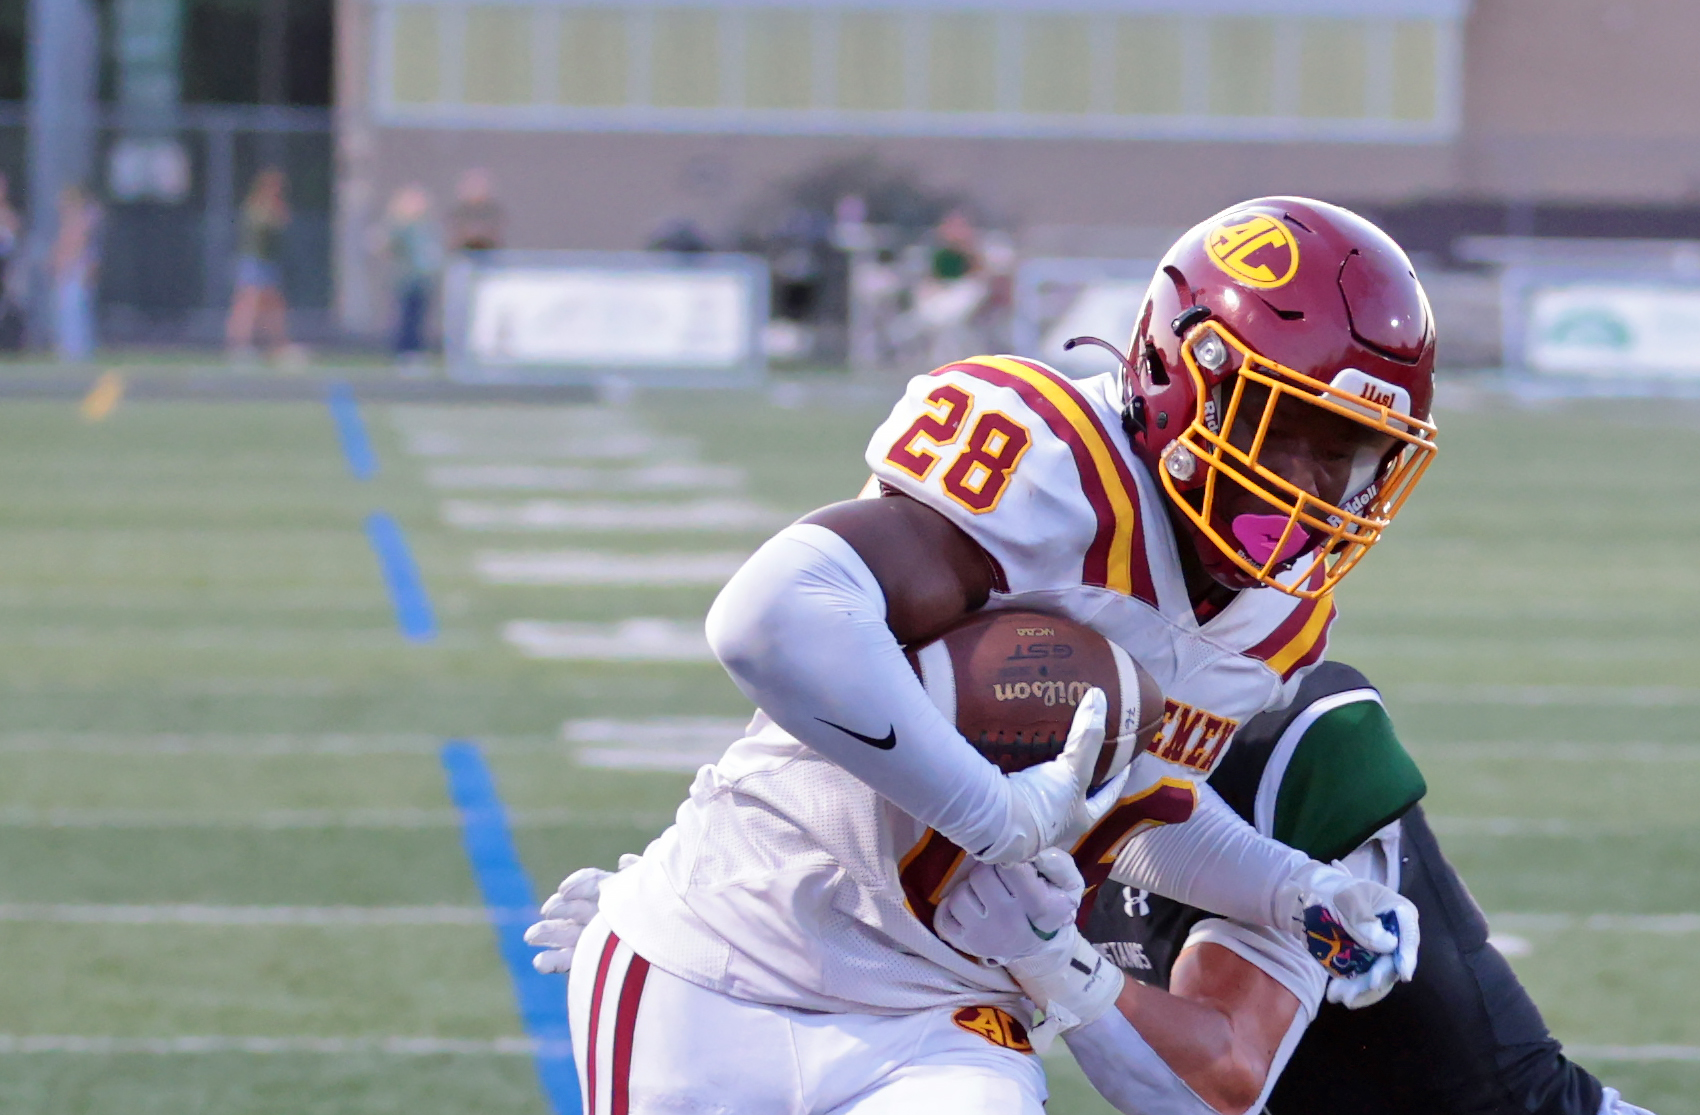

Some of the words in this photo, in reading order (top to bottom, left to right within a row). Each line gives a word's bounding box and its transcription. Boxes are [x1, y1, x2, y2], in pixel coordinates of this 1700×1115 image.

[883, 383, 1033, 515] 28
[1326, 485, 1378, 528] Rddell
[1016, 627, 1056, 638] NCAA
[1006, 643, 1074, 660] GST
[993, 681, 1096, 708] Wilson
[1092, 941, 1153, 970] STANGS
